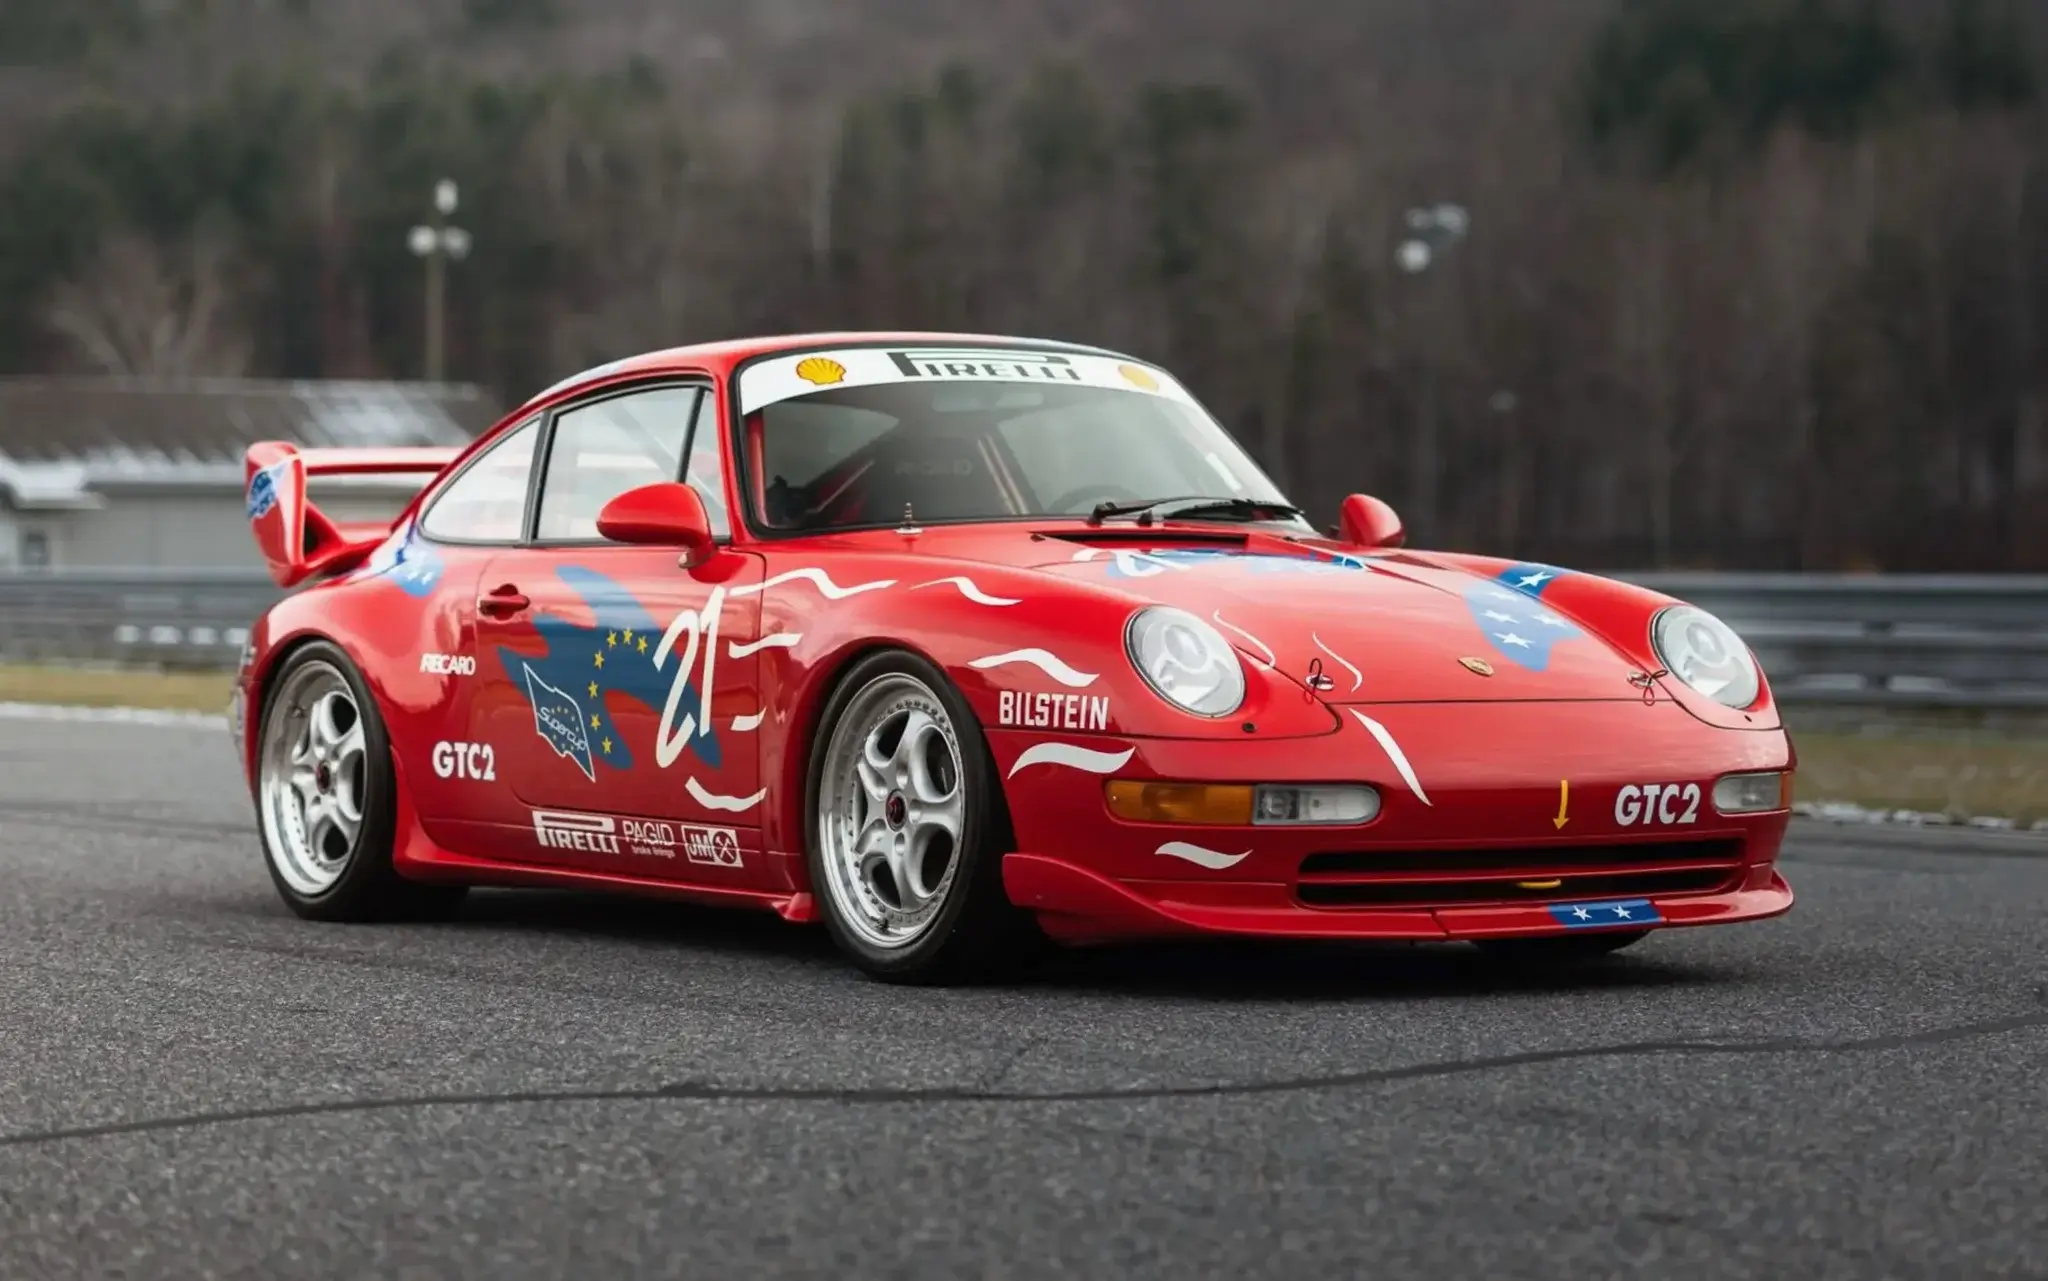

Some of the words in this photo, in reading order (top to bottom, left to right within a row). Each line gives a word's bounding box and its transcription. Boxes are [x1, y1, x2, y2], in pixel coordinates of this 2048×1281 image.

[887, 351, 1081, 381] PIRELLI
[420, 653, 476, 675] RECARO
[653, 585, 726, 768] 21
[538, 706, 586, 751] Supercup
[1000, 691, 1108, 730] BILSTEIN
[432, 741, 496, 781] GTC2
[1615, 783, 1701, 826] GTC2
[532, 810, 620, 854] PIRELLI
[622, 820, 675, 846] PAGID
